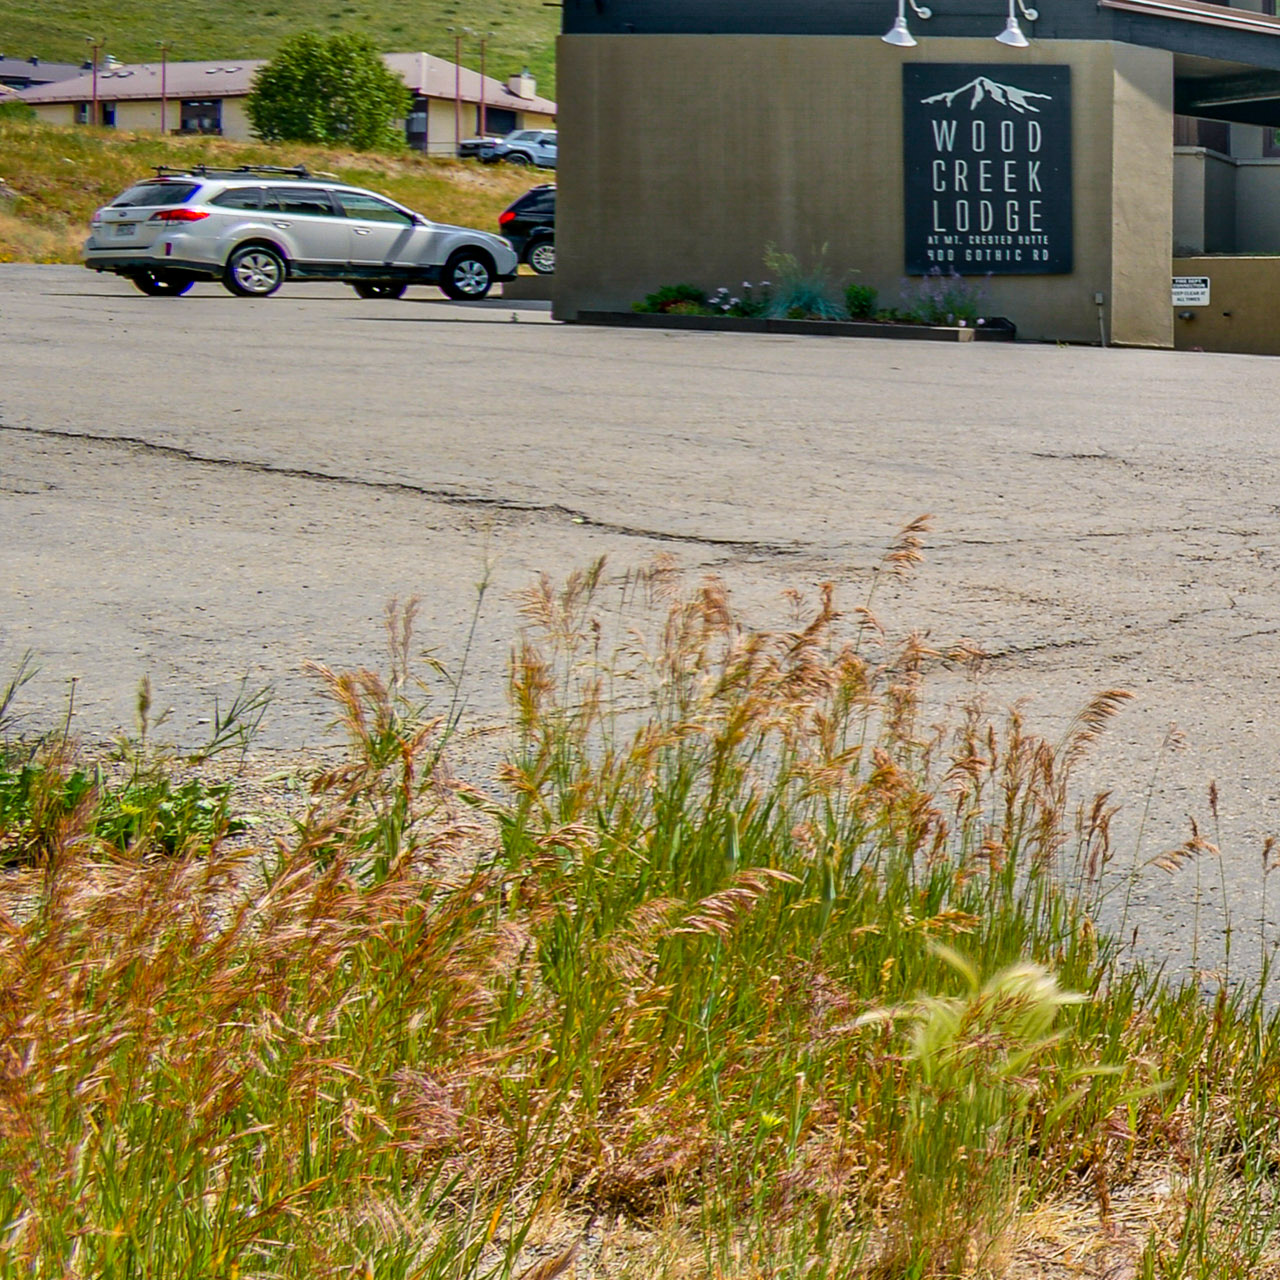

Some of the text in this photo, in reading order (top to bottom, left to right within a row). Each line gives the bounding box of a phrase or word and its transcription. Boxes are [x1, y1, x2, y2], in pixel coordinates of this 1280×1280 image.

[932, 120, 1042, 152] WOOD
[932, 160, 1042, 192] CREEK
[932, 199, 1043, 232] LODGE
[928, 235, 1049, 245] AT MT. CRESTED BUTTE
[965, 249, 1022, 261] GOTHIC
[1032, 249, 1049, 261] RD
